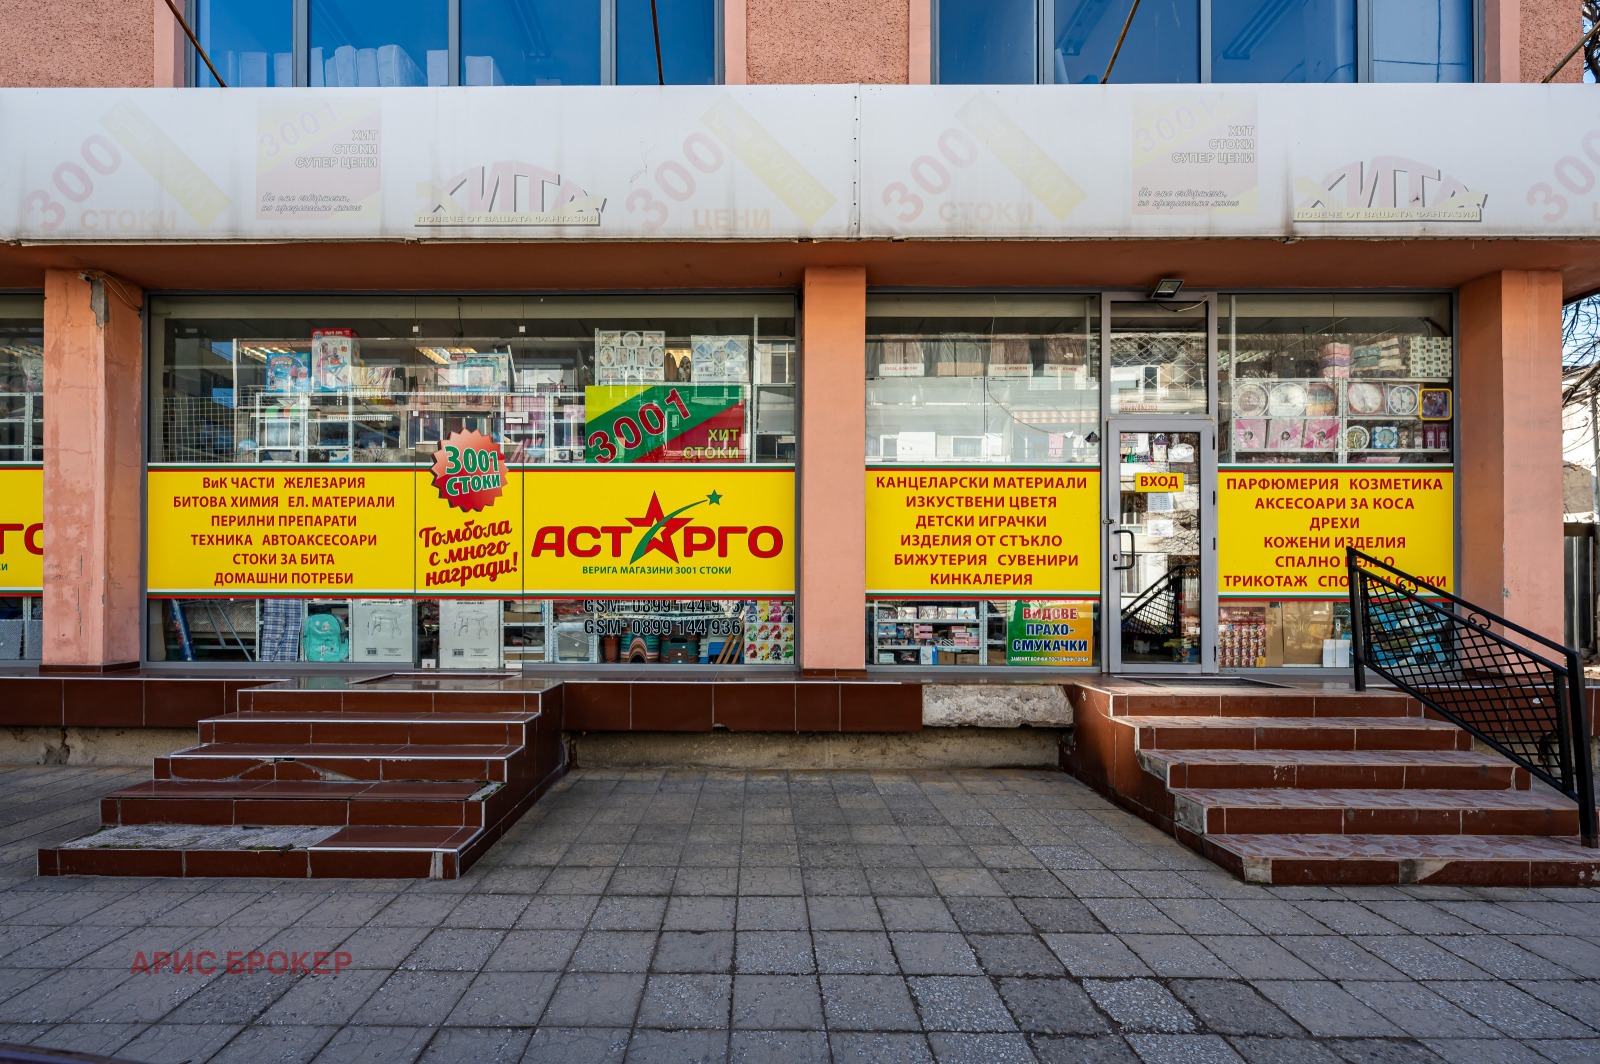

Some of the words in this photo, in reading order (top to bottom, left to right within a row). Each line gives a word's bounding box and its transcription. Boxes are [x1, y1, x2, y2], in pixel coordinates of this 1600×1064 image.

[352, 130, 378, 141] ХИТ
[1228, 126, 1254, 137] ХИТ
[332, 143, 378, 154] СТОКИ
[1208, 139, 1254, 149] СТОКИ
[295, 157, 338, 168] СУПЕР
[341, 157, 378, 169] ЦЕНИ
[1171, 152, 1215, 163] СУПЕР
[1218, 152, 1254, 165] ЦЕНИ
[418, 215, 463, 223] ПОВЕЧЕ
[467, 215, 482, 223] ОТ
[484, 215, 533, 223] ВАШАТА
[535, 215, 598, 223] ФАНТАЗИЯ
[692, 208, 771, 231] ЦЕНИ
[1363, 211, 1413, 219] ВАШАТА
[1416, 210, 1479, 219] ФАНТАЗИЯ
[588, 388, 691, 463] 3001
[708, 429, 739, 441] ХИТ
[683, 447, 739, 459] СТОКИ
[445, 445, 500, 475] 3001
[203, 477, 227, 489] ВиК
[231, 477, 274, 489] ЧАСТИ
[284, 477, 365, 489] ЖЕЛЕЗАРИЯ
[446, 474, 501, 496] СТОКИ
[876, 476, 989, 490] КАНЦЕЛАРСКИ
[993, 477, 1087, 489] МАТЕРИАЛИ
[1140, 476, 1179, 489] ВХОД
[1226, 478, 1339, 490] ПАРФЮМЕРИЯ
[1349, 478, 1443, 490] КОЗМЕТИКА
[174, 496, 227, 508] БИТОВА
[231, 496, 279, 508] ХИМИЯ
[288, 496, 308, 508] ЕЛ.
[312, 496, 395, 508] МАТЕРИАЛИ
[906, 496, 1005, 508] ИЗКУСТВЕНИ
[1009, 496, 1057, 510] ЦВЕТЯ
[1255, 498, 1346, 510] АКСЕСОАРИ
[1350, 498, 1369, 510] ЗА
[1373, 498, 1415, 510] КОСА
[211, 515, 275, 527] ПЕРИЛНИ
[279, 515, 357, 527] ПРЕПАРАТИ
[916, 515, 975, 529] ДЕТСКИ
[979, 515, 1047, 528] ИГРАЧКИ
[1309, 517, 1360, 531] ДРЕХИ
[191, 534, 253, 546] ТЕХНИКА
[262, 534, 377, 546] АВТОАКСЕСОАРИ
[419, 519, 512, 548] Томбола
[901, 535, 972, 548] ИЗДЕЛИЯ
[976, 535, 996, 547] ОТ
[999, 535, 1063, 547] СТЪКЛО
[1264, 537, 1330, 549] КОЖЕНИ
[1334, 537, 1406, 550] ИЗДЕЛИЯ
[233, 553, 277, 565] СТОКИ
[281, 553, 297, 565] ЗА
[301, 553, 335, 565] БИТА
[429, 551, 441, 566] с
[444, 540, 511, 564] много
[894, 554, 987, 566] БИЖУТЕРИЯ
[997, 554, 1079, 567] СУВЕНИРИ
[1275, 556, 1341, 568] СПАЛНО
[425, 552, 518, 587] награди!
[582, 566, 618, 574] ВЕРИГА
[620, 566, 673, 574] МАГАЗИНИ
[675, 566, 697, 574] 3001
[699, 566, 732, 574] СТОКИ
[214, 573, 288, 586] ДОМАШНИ
[292, 573, 353, 585] ПОТРЕБИ
[930, 573, 1033, 586] КИНКАЛЕРИЯ
[1224, 575, 1308, 587] ТРИКОТАЖ
[632, 600, 672, 613] 0899
[677, 600, 706, 613] 144
[1023, 608, 1078, 621] ВИДОВЕ
[632, 619, 672, 635] 0899
[676, 619, 707, 635] 144
[711, 619, 741, 635] 936
[1026, 623, 1075, 636] ПРАХО-
[1012, 639, 1089, 652] СМУКАЧКИ
